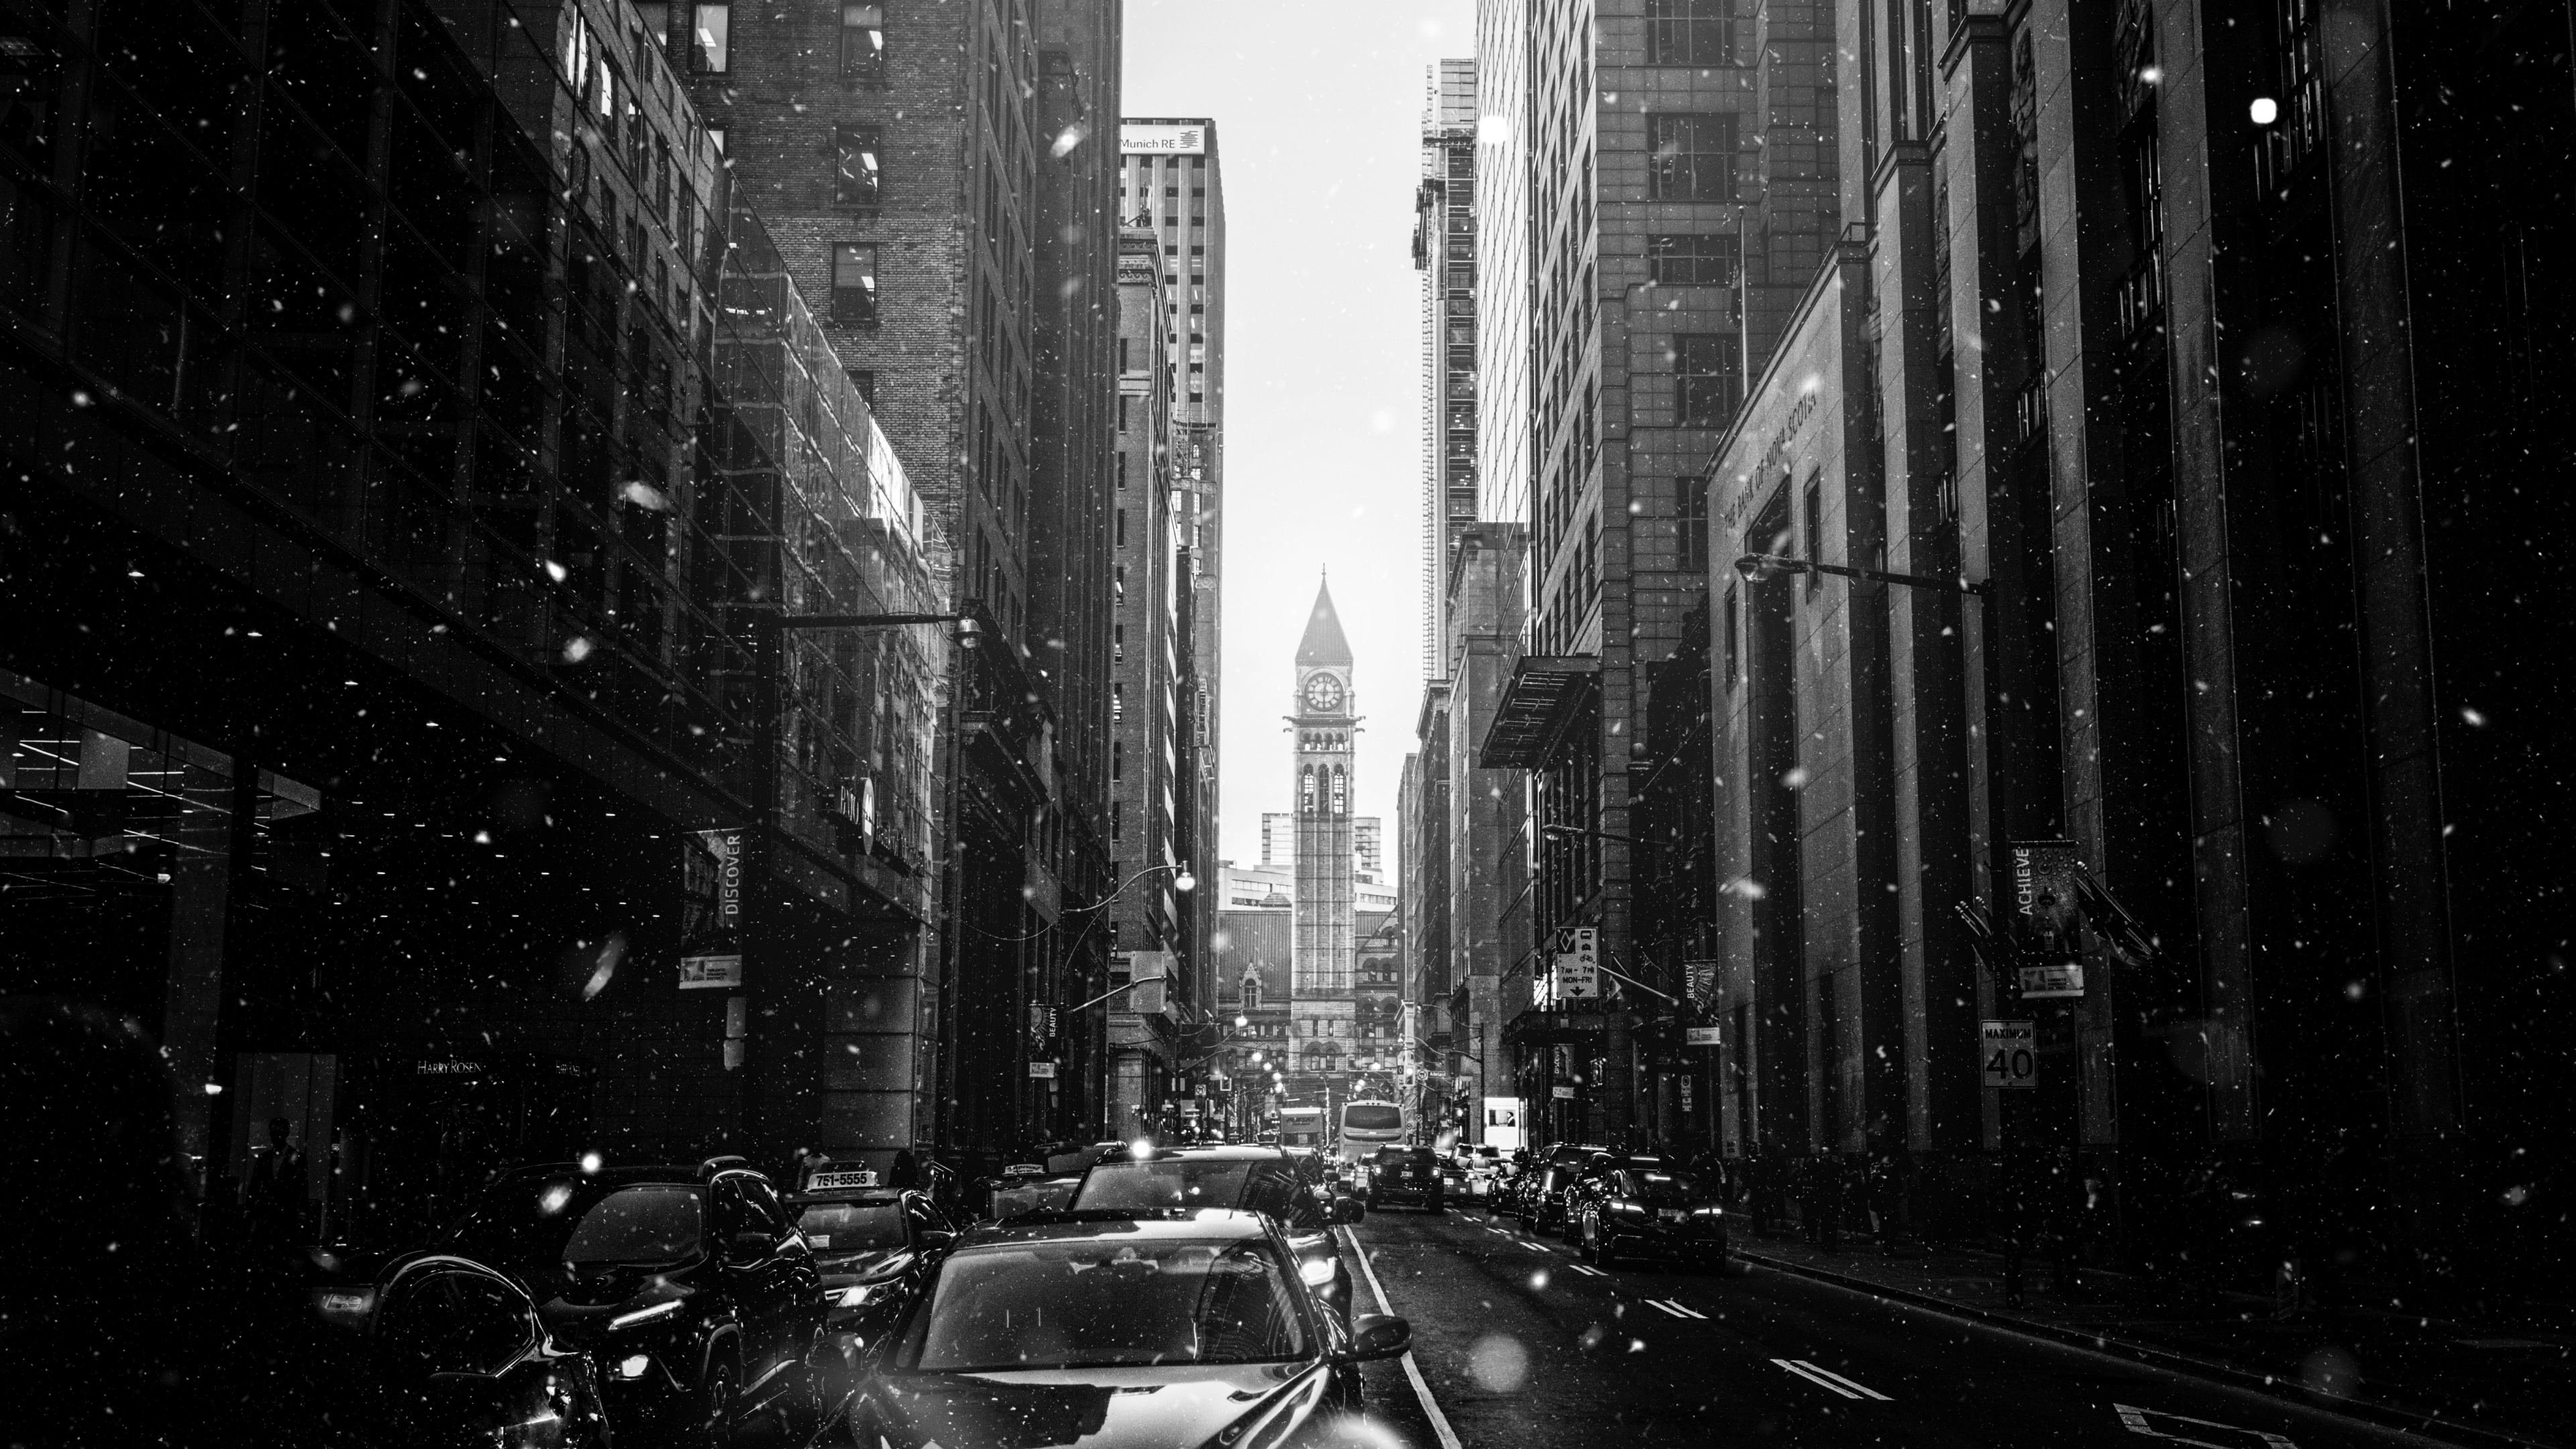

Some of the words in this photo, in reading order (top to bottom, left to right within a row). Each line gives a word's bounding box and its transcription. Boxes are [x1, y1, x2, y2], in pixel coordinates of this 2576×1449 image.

[1121, 139, 1159, 148] Munich
[1161, 140, 1175, 148] RE
[1724, 504, 1735, 537] THE
[1738, 475, 1754, 519] BANK
[1756, 459, 1764, 490] OF
[1767, 426, 1786, 476] NOVA
[725, 835, 741, 915] DISCOVER
[2015, 848, 2033, 915] ACHIEVE
[1686, 965, 1695, 999] BEAUTY
[1049, 1007, 1057, 1038] BEAUTY
[1985, 1028, 2031, 1039] MAXIMUM
[417, 1060, 449, 1074] HARRY
[450, 1059, 482, 1073] ROSEN
[1986, 1049, 2034, 1079] 40
[816, 1173, 867, 1186] 751-5555
